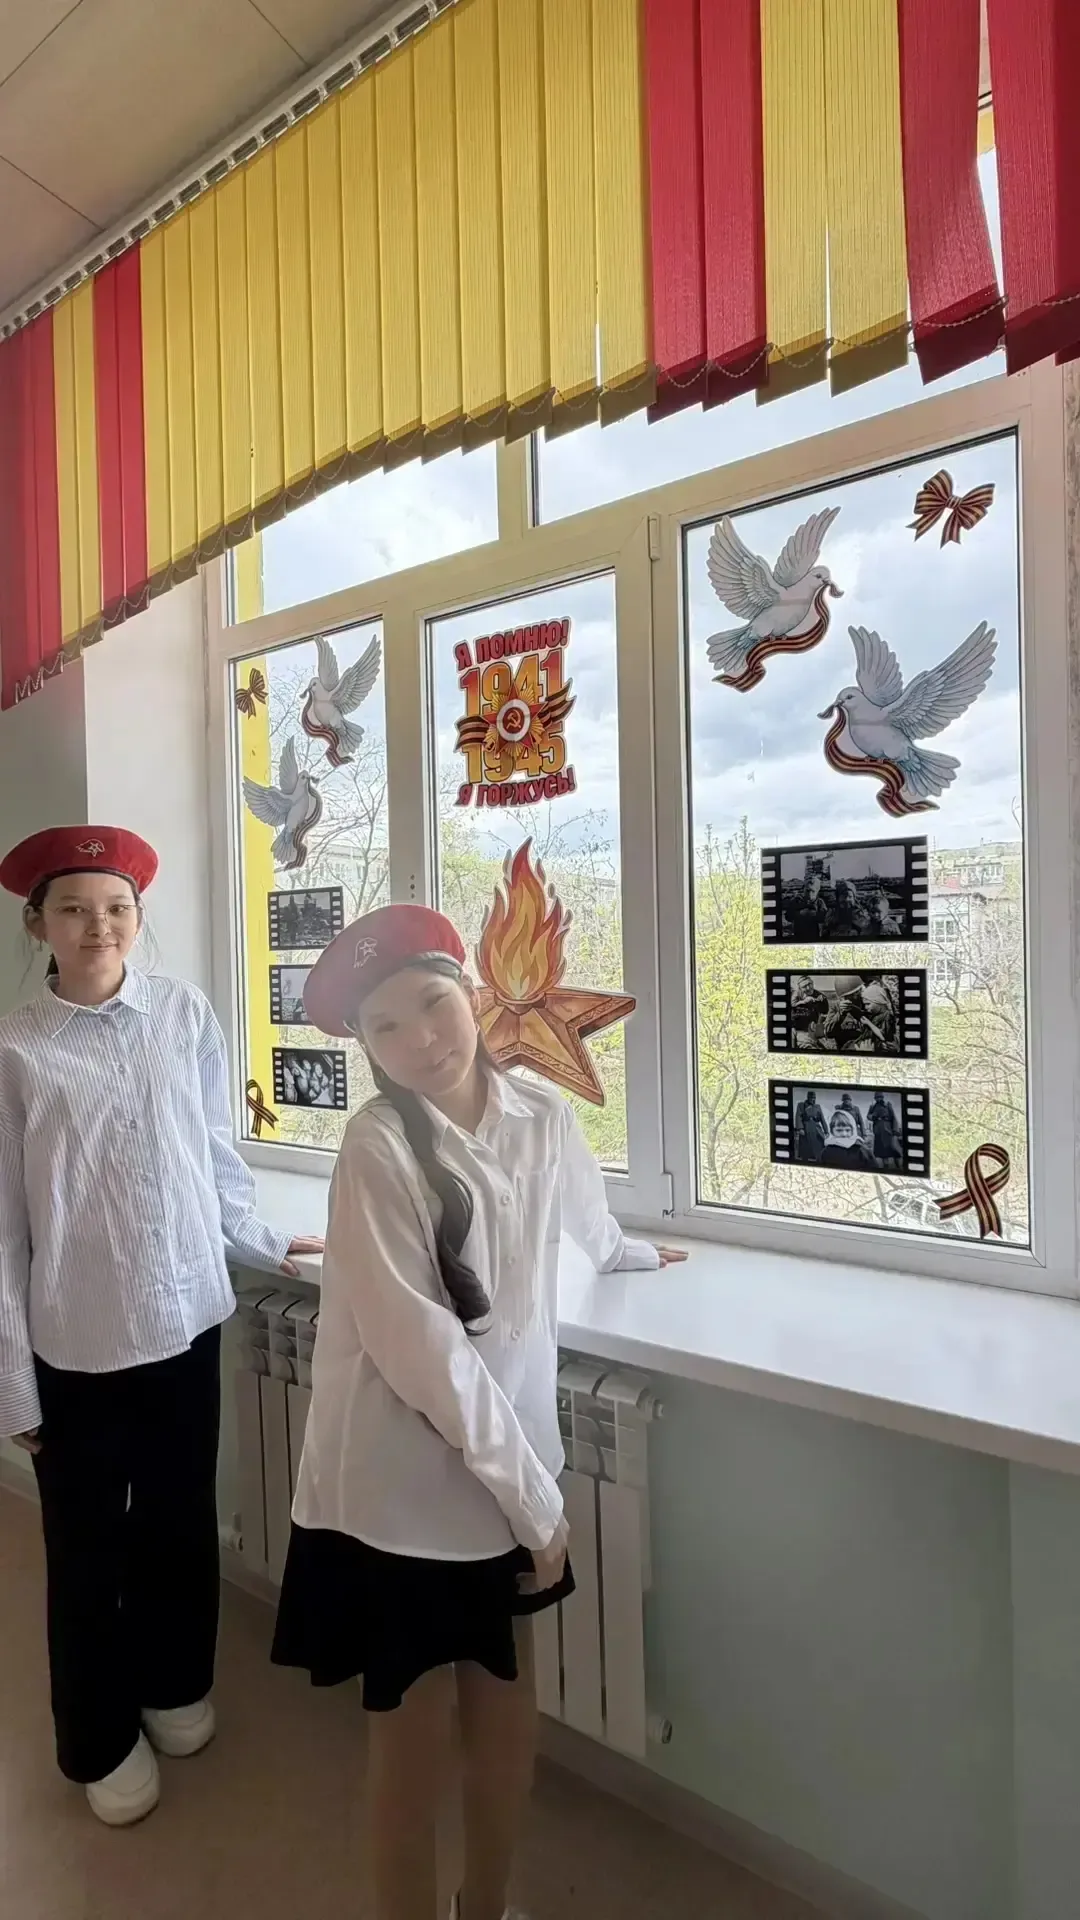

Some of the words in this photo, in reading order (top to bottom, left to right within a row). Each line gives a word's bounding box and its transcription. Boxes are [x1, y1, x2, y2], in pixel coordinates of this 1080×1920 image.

[454, 642, 472, 671] Я
[475, 619, 569, 663] ПОМНЮ!
[459, 648, 563, 716] 1941
[456, 783, 473, 806] Я
[477, 767, 576, 807] ГОРЖУСЬ!
